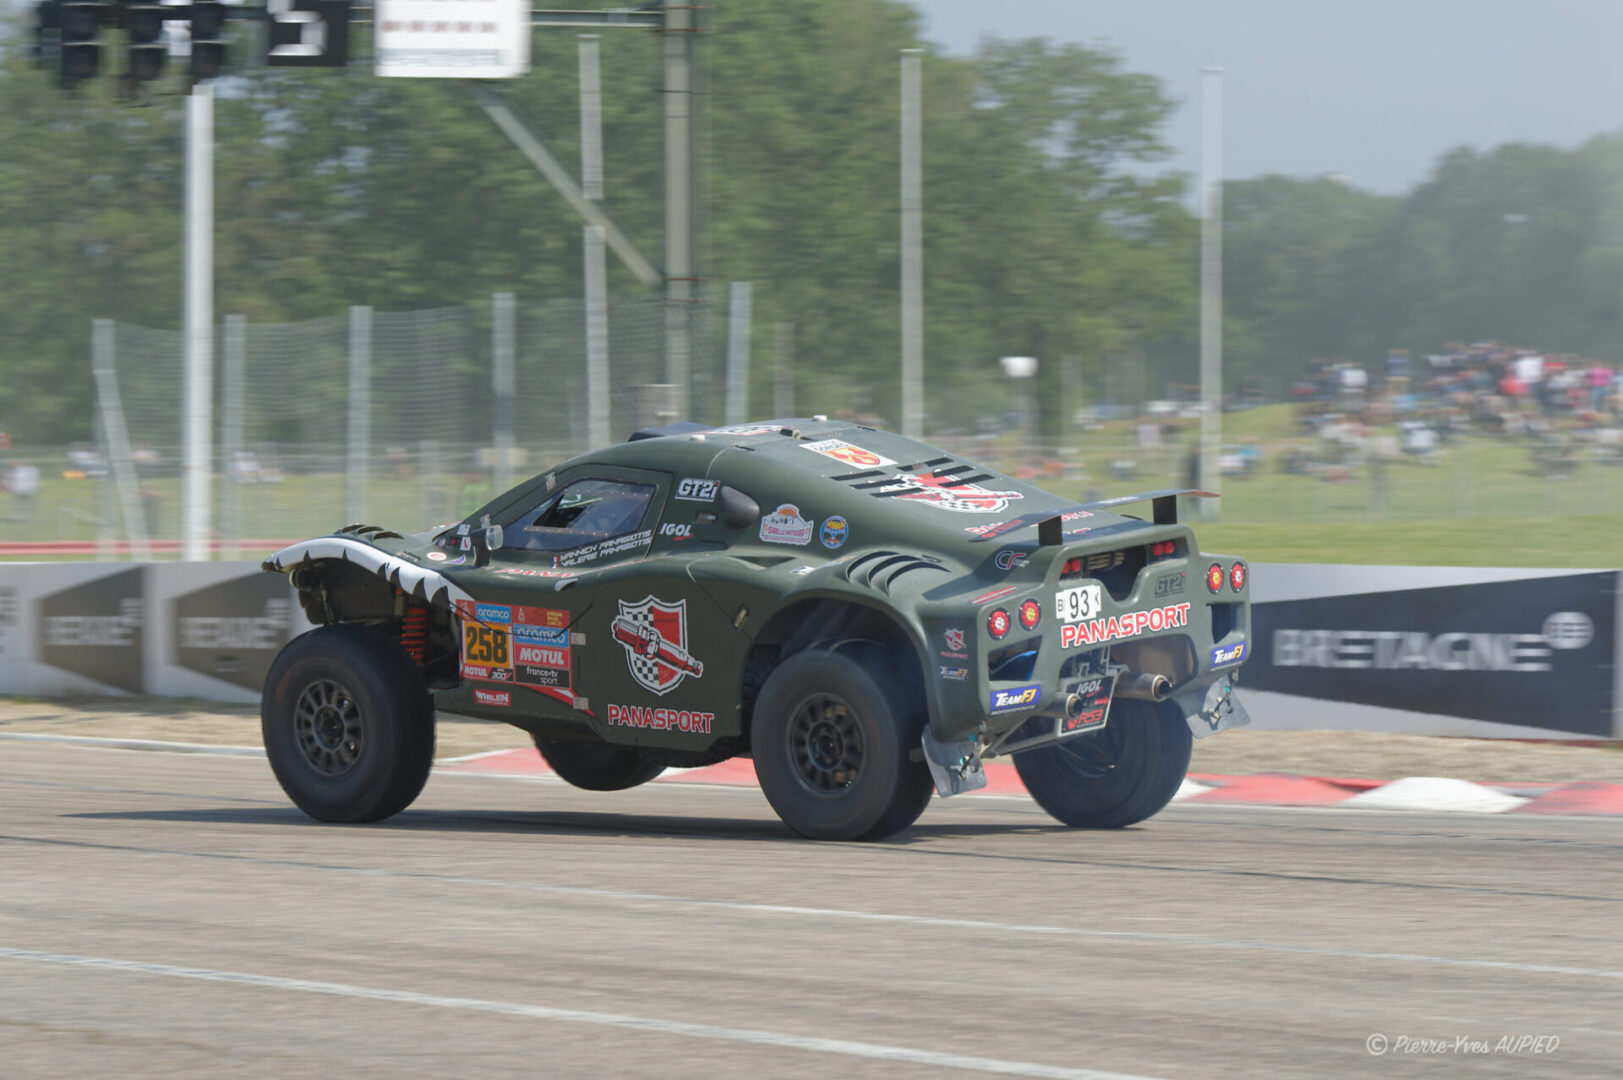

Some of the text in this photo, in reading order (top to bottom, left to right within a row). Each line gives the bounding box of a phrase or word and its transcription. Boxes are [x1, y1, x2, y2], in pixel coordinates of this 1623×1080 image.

[677, 479, 720, 499] GT2i
[659, 523, 692, 537] IGOL
[1069, 589, 1090, 619] 93
[477, 608, 510, 619] aramco
[1061, 602, 1190, 648] PANASPORT
[466, 626, 508, 664] 258
[517, 628, 566, 644] aramco
[519, 647, 565, 665] MOTUL
[1273, 629, 1552, 672] BRETAGNE
[463, 666, 488, 677] MOTUL
[540, 676, 558, 686] sport
[1076, 680, 1101, 695] IGOL
[607, 704, 715, 734] PANASPORT
